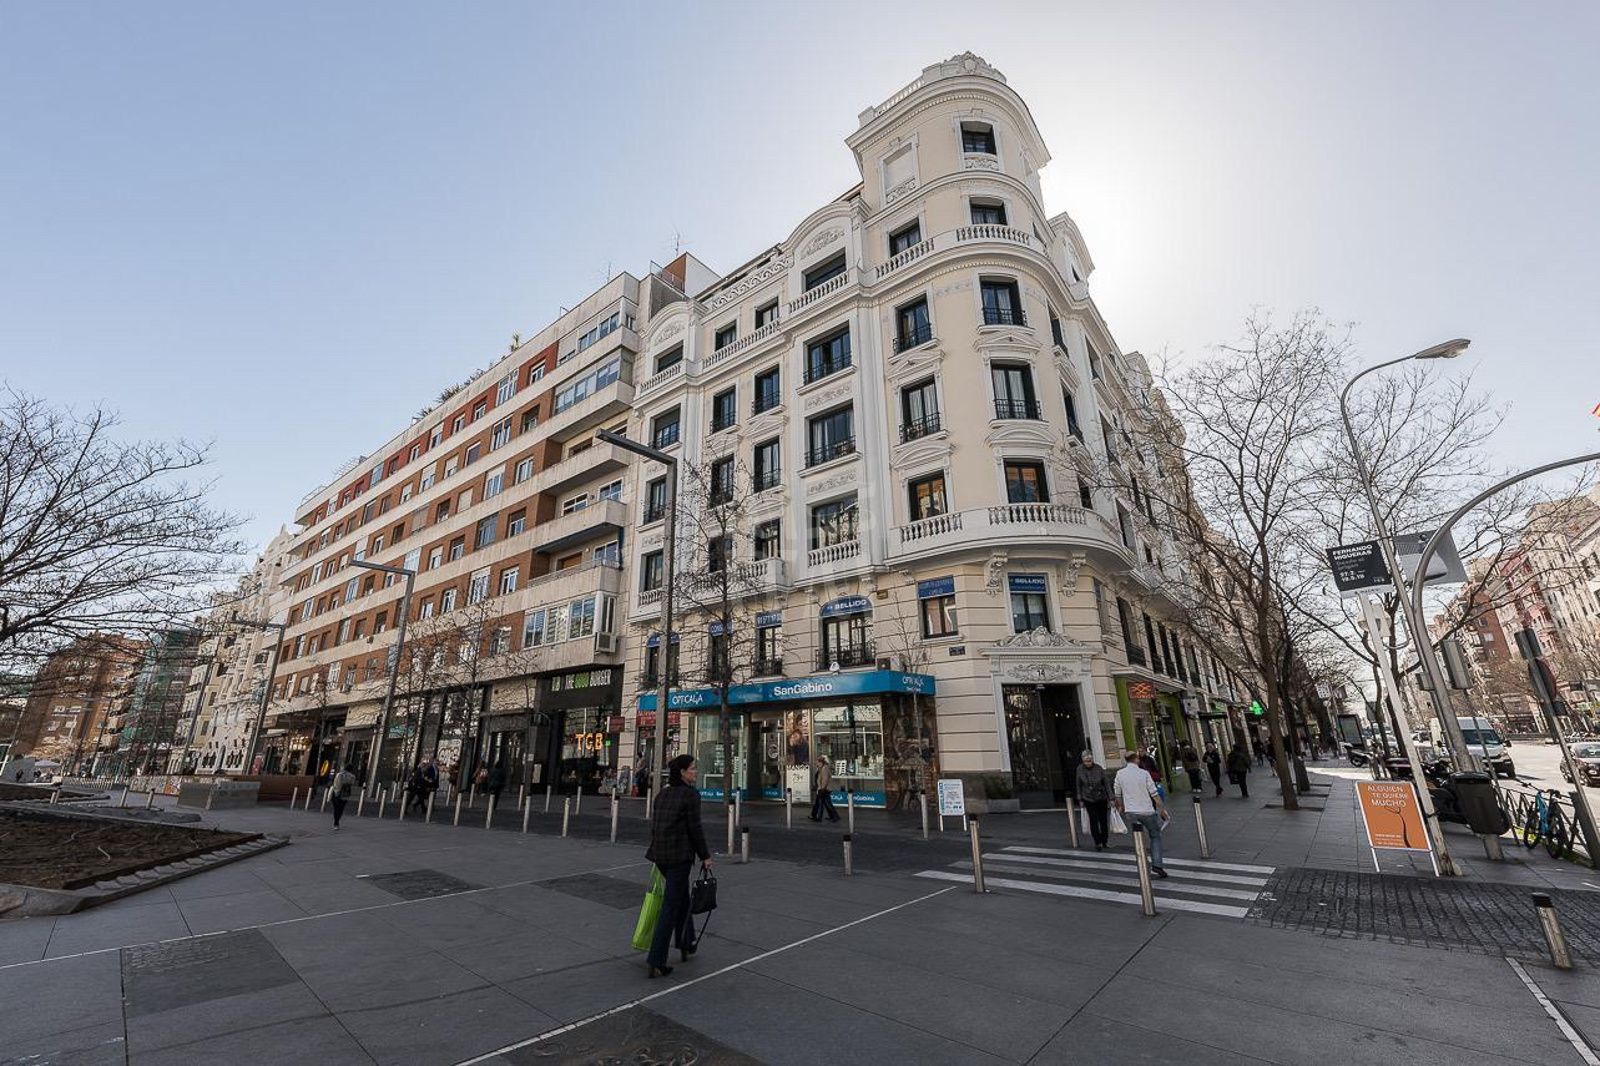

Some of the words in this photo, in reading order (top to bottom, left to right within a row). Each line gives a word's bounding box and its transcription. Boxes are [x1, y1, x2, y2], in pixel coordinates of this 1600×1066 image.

[1332, 544, 1373, 556] FERNANDO
[1333, 550, 1373, 561] HIGUERAS
[773, 682, 833, 696] SanGabino
[1371, 799, 1406, 808] MUCHO
